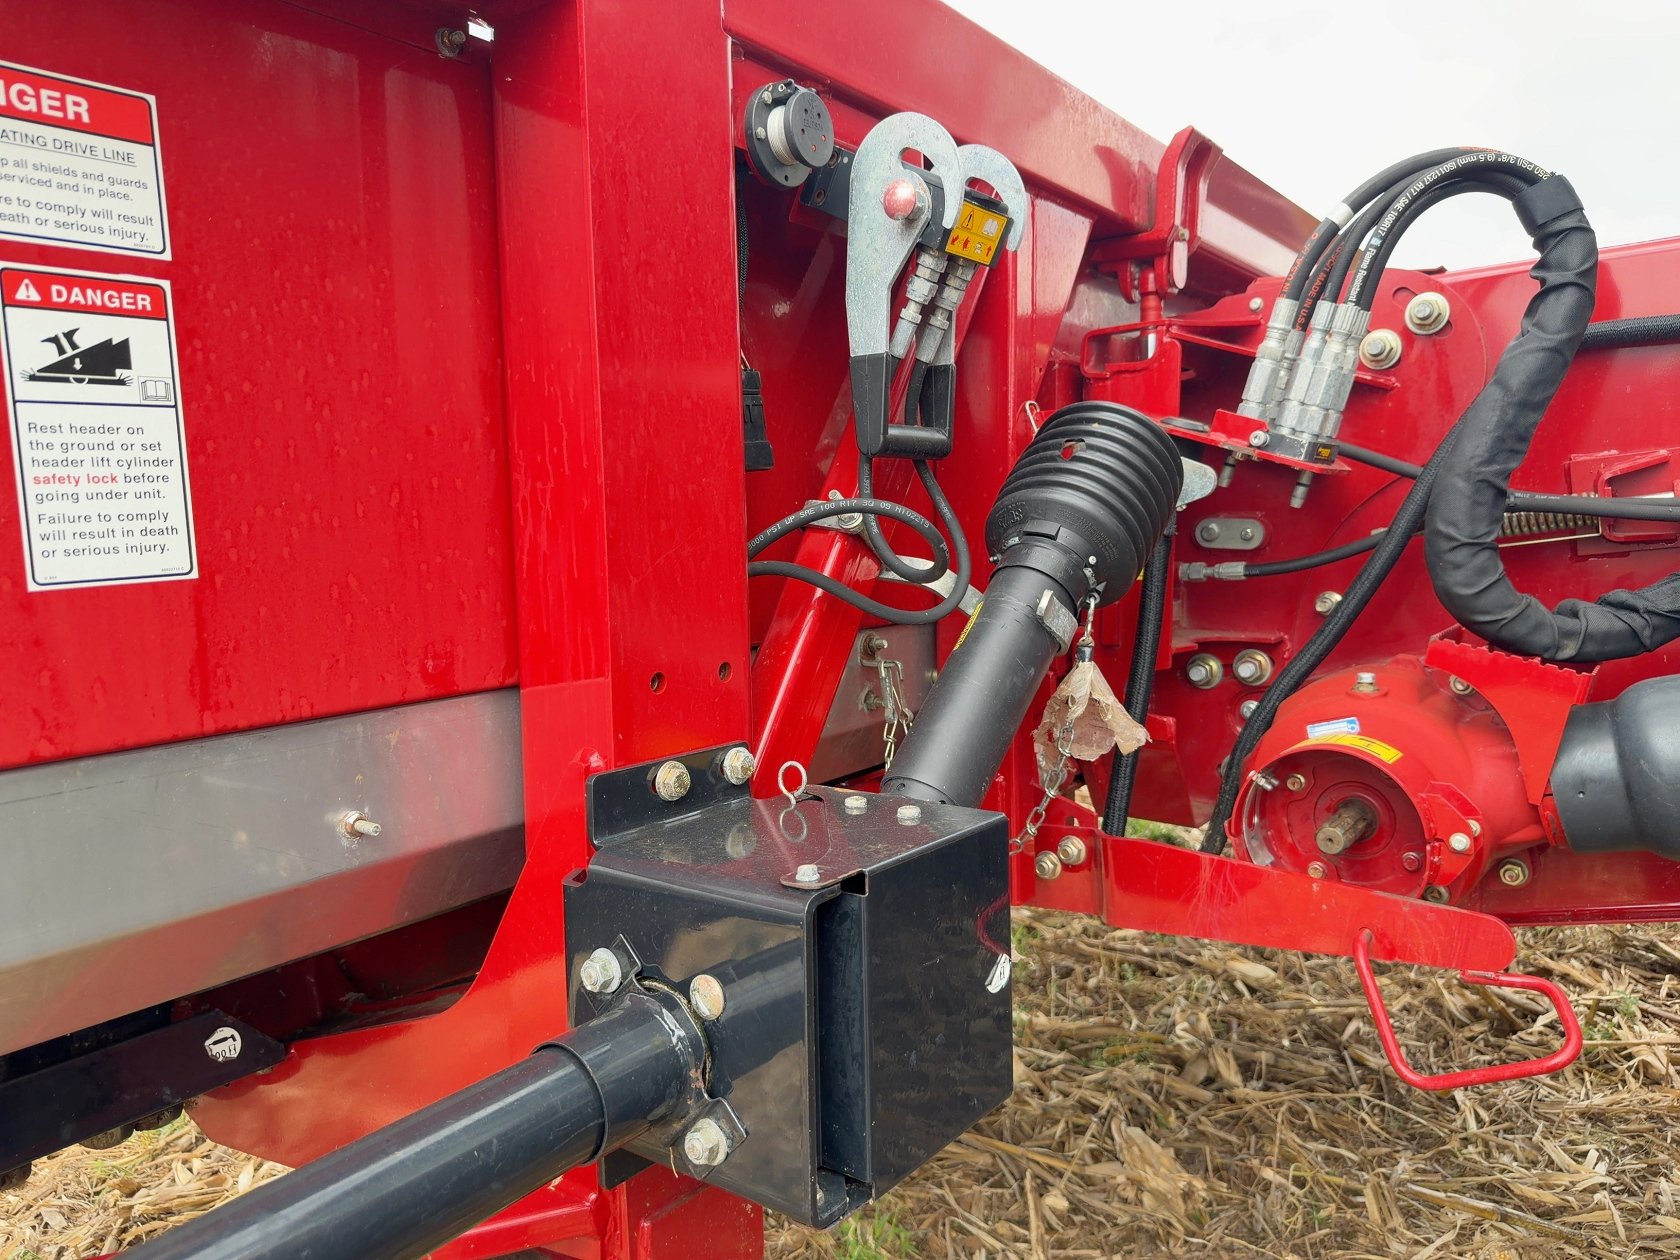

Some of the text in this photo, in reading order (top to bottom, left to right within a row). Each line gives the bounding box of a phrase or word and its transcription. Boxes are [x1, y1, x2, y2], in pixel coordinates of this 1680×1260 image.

[0, 129, 136, 164] ATING DRIVE LINE
[1458, 154, 1476, 168] mm)
[13, 158, 28, 169] all
[32, 162, 78, 178] shields
[82, 170, 104, 182] and
[108, 174, 148, 190] guards
[56, 182, 80, 192] and
[83, 184, 94, 195] in
[98, 188, 134, 202] place.
[1410, 181, 1424, 195] R17
[17, 196, 31, 208] to
[36, 201, 86, 218] comply
[91, 208, 114, 220] will
[117, 212, 154, 226] result
[1394, 196, 1409, 212] SAE
[35, 217, 50, 227] or
[54, 220, 104, 235] serious
[109, 225, 149, 242] injury.
[1378, 210, 1398, 236] 100R17
[1360, 248, 1376, 269] Flame
[1308, 272, 1327, 298] MADE
[1348, 270, 1367, 302] Resistant
[51, 284, 152, 311] DANGER
[1304, 299, 1313, 310] IN
[28, 422, 144, 435] Rest header on
[29, 440, 162, 453] the ground or set
[32, 456, 174, 470] header lift cylinder
[33, 472, 170, 486] safety lock before
[35, 488, 166, 504] going under unit.
[38, 510, 170, 525] Failure to comply
[766, 524, 782, 536] PSI
[800, 508, 816, 518] SAE
[820, 502, 836, 511] 100
[40, 525, 178, 542] will result in death
[42, 542, 170, 558] or serious injury.
